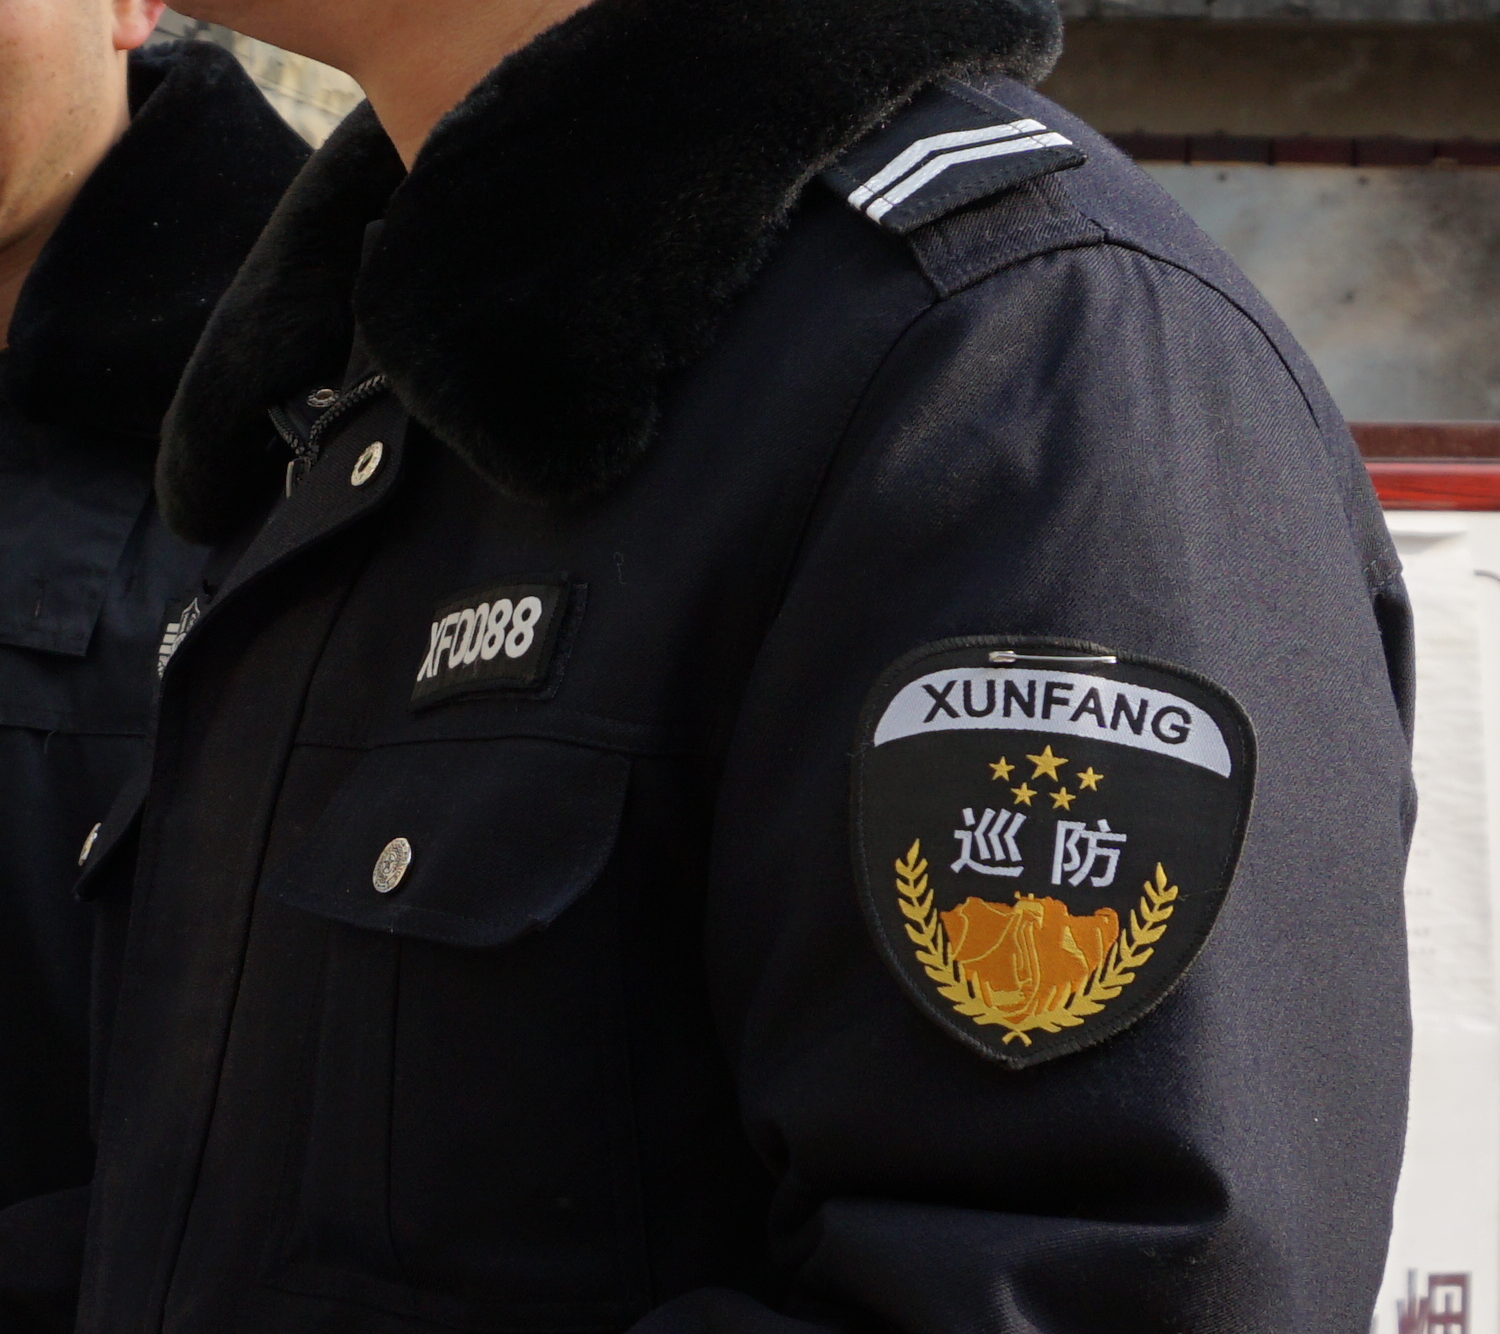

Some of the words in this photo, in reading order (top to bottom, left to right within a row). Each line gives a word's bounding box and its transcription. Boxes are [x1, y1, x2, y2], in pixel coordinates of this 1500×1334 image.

[417, 595, 543, 683] XF0088
[922, 679, 1192, 746] XUNFANG
[950, 807, 1128, 888] 巡防
